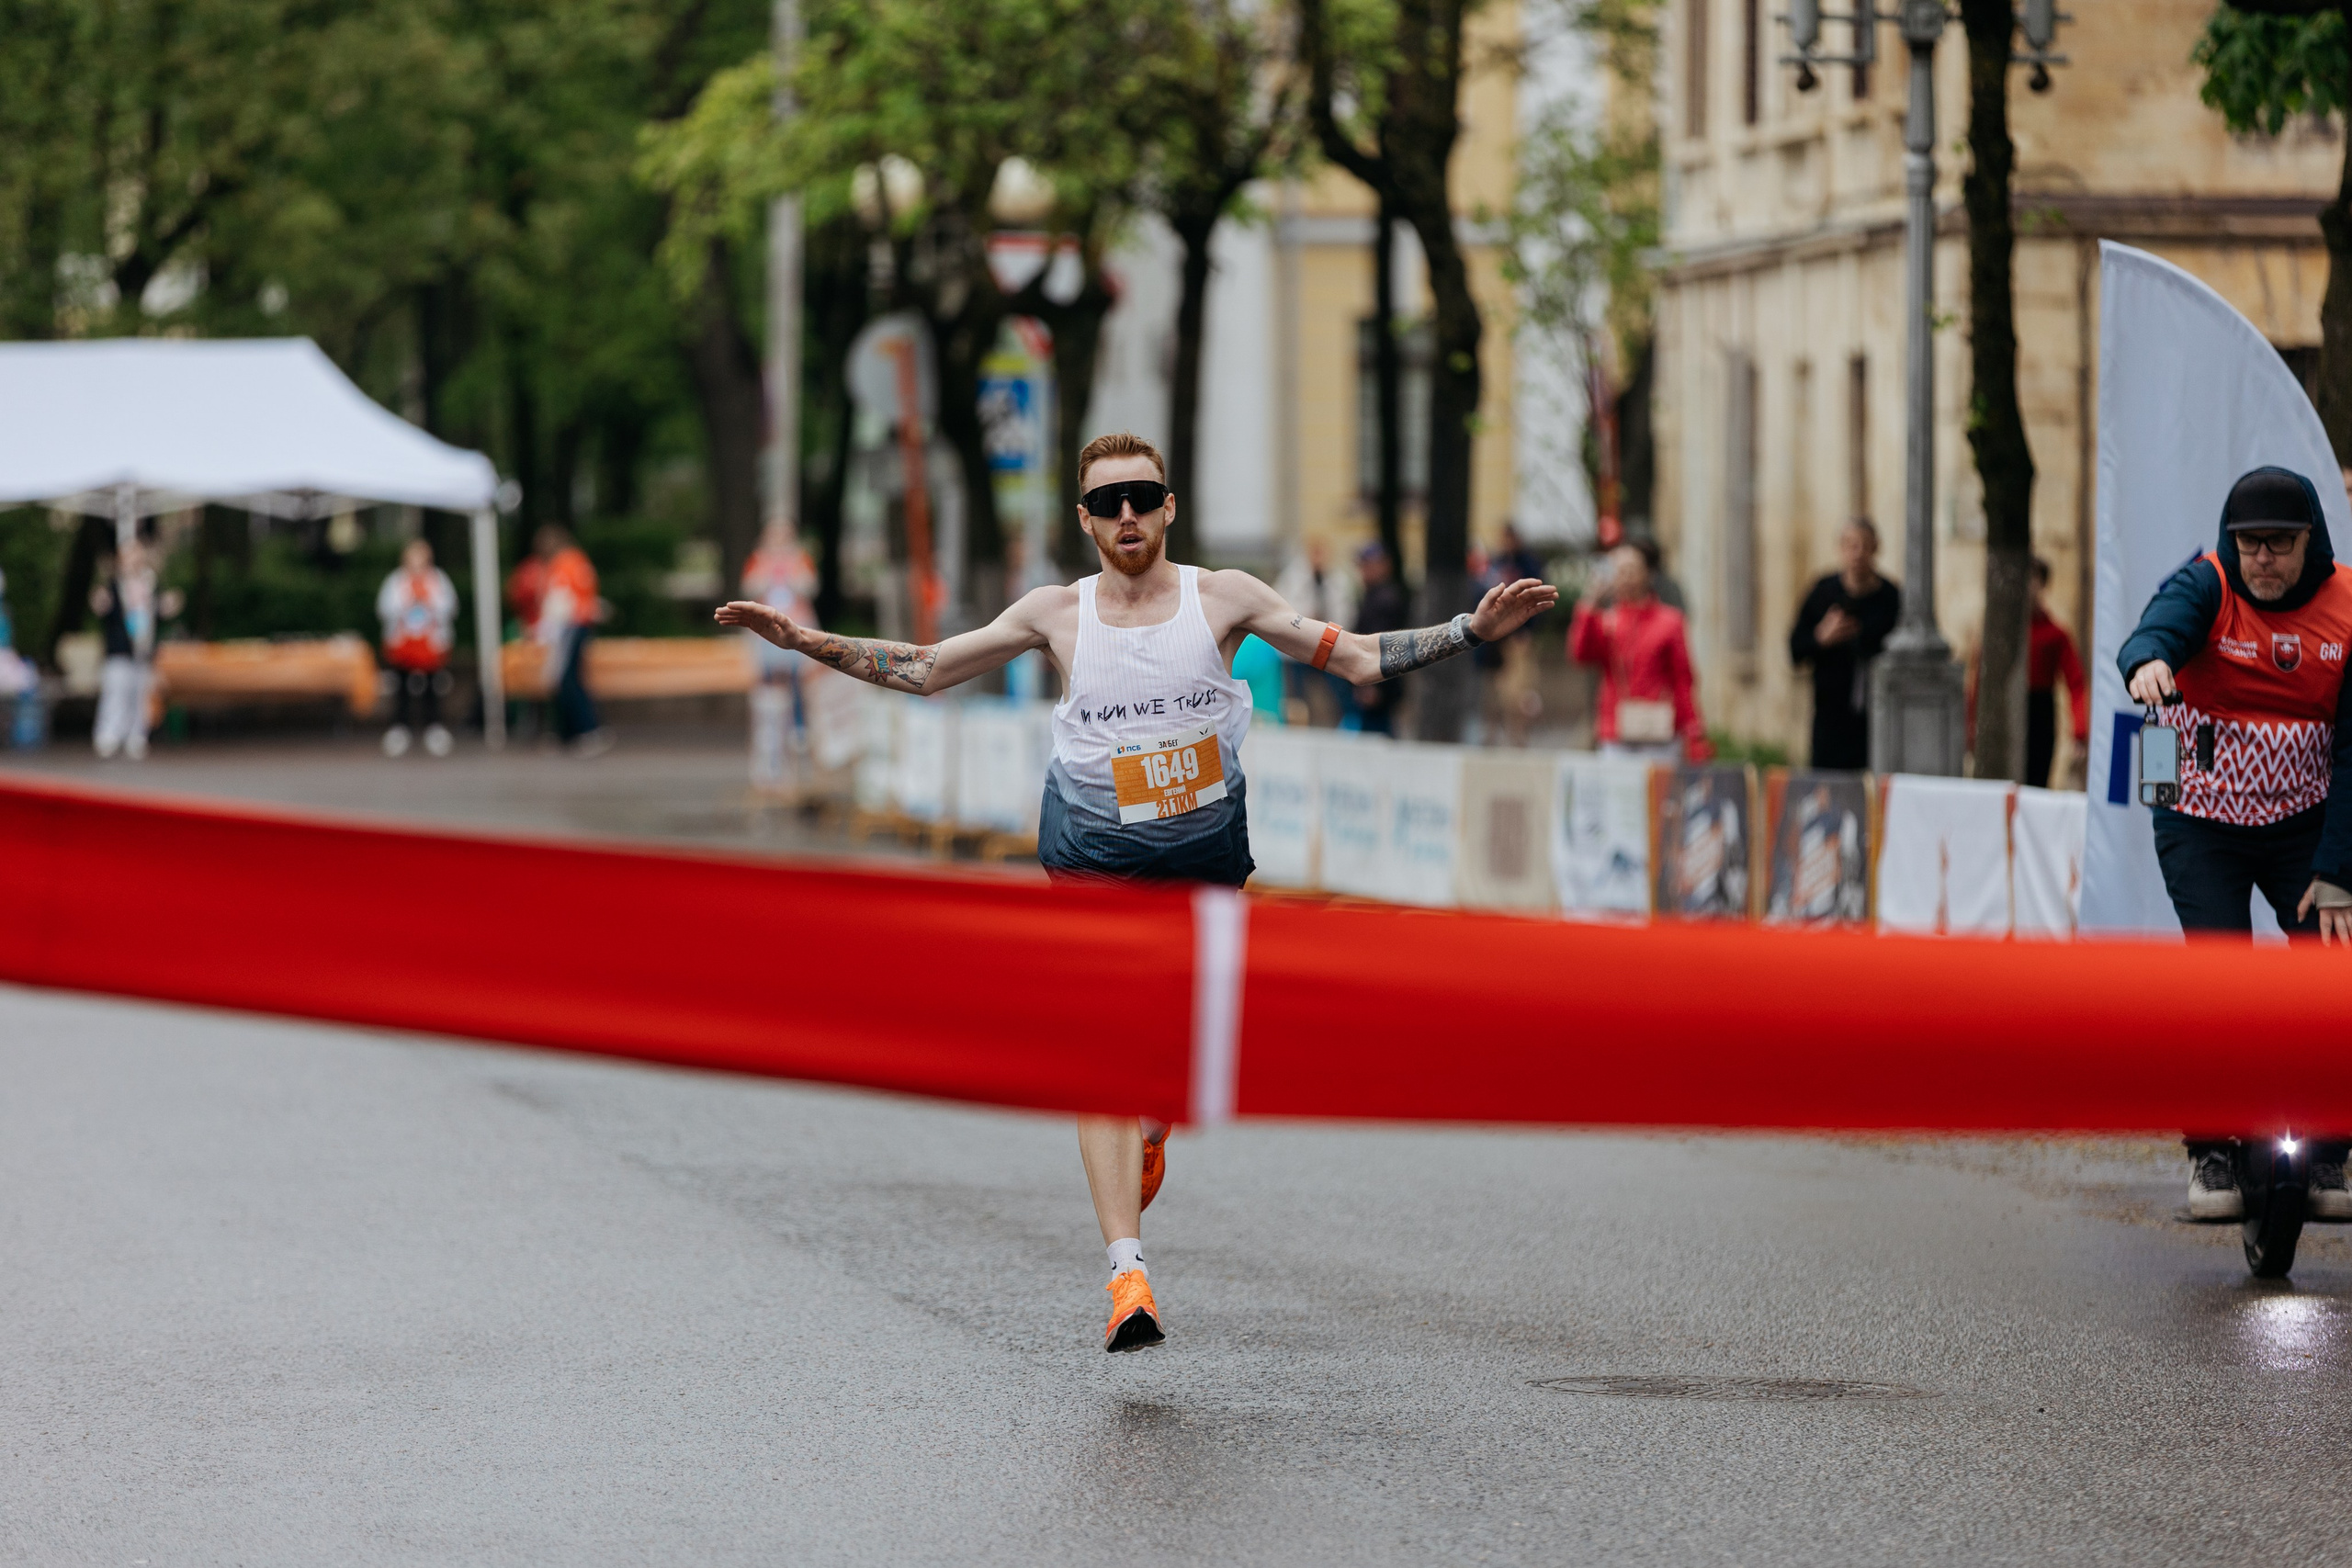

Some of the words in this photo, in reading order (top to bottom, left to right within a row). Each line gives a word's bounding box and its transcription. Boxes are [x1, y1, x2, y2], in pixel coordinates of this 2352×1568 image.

[1097, 705, 1126, 722] RUN
[1134, 698, 1165, 716] WE
[1173, 689, 1218, 711] TRUST
[1126, 744, 1141, 752] ПСБ
[1140, 747, 1199, 789] 1649
